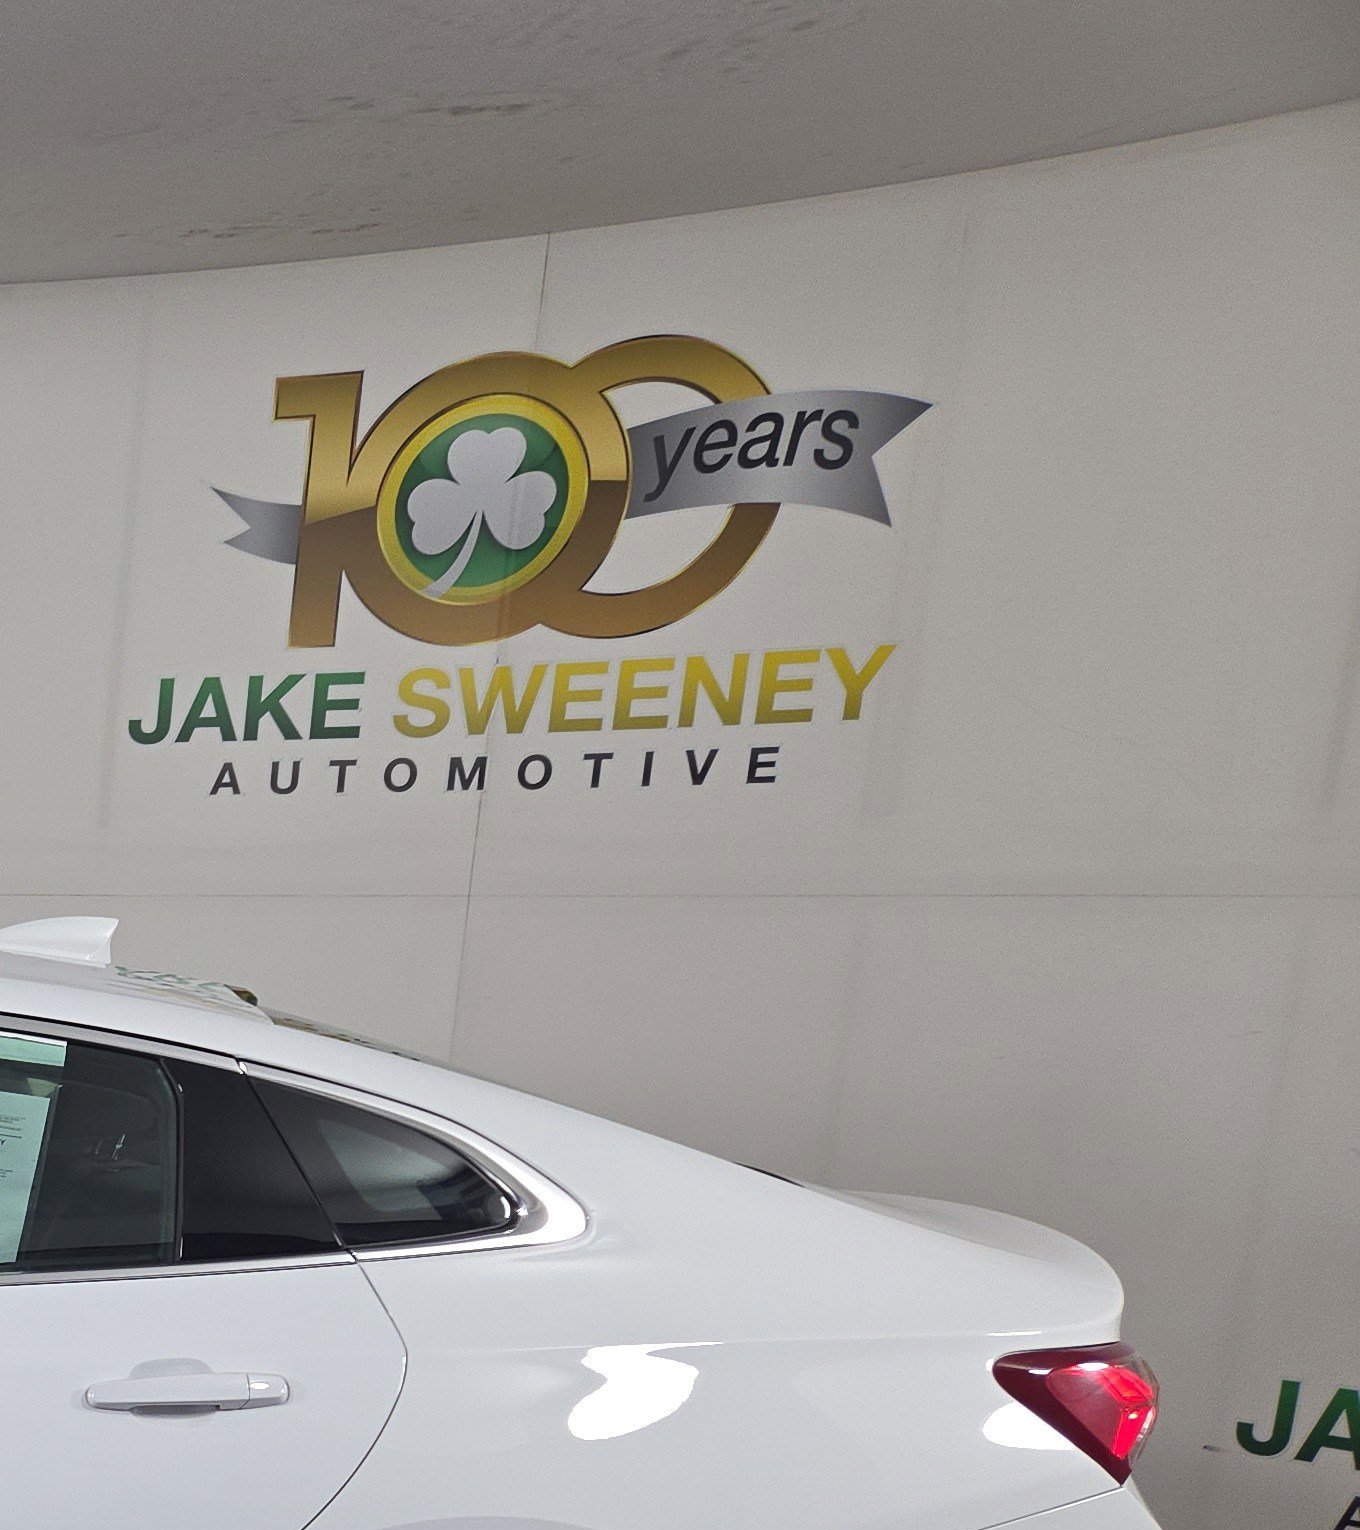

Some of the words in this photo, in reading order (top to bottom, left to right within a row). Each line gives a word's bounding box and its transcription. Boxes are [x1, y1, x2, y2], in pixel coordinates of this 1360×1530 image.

[645, 405, 860, 503] years
[128, 671, 367, 744] JAKE
[393, 644, 898, 738] SWEENEY
[210, 746, 781, 797] AUTOMOTIVE
